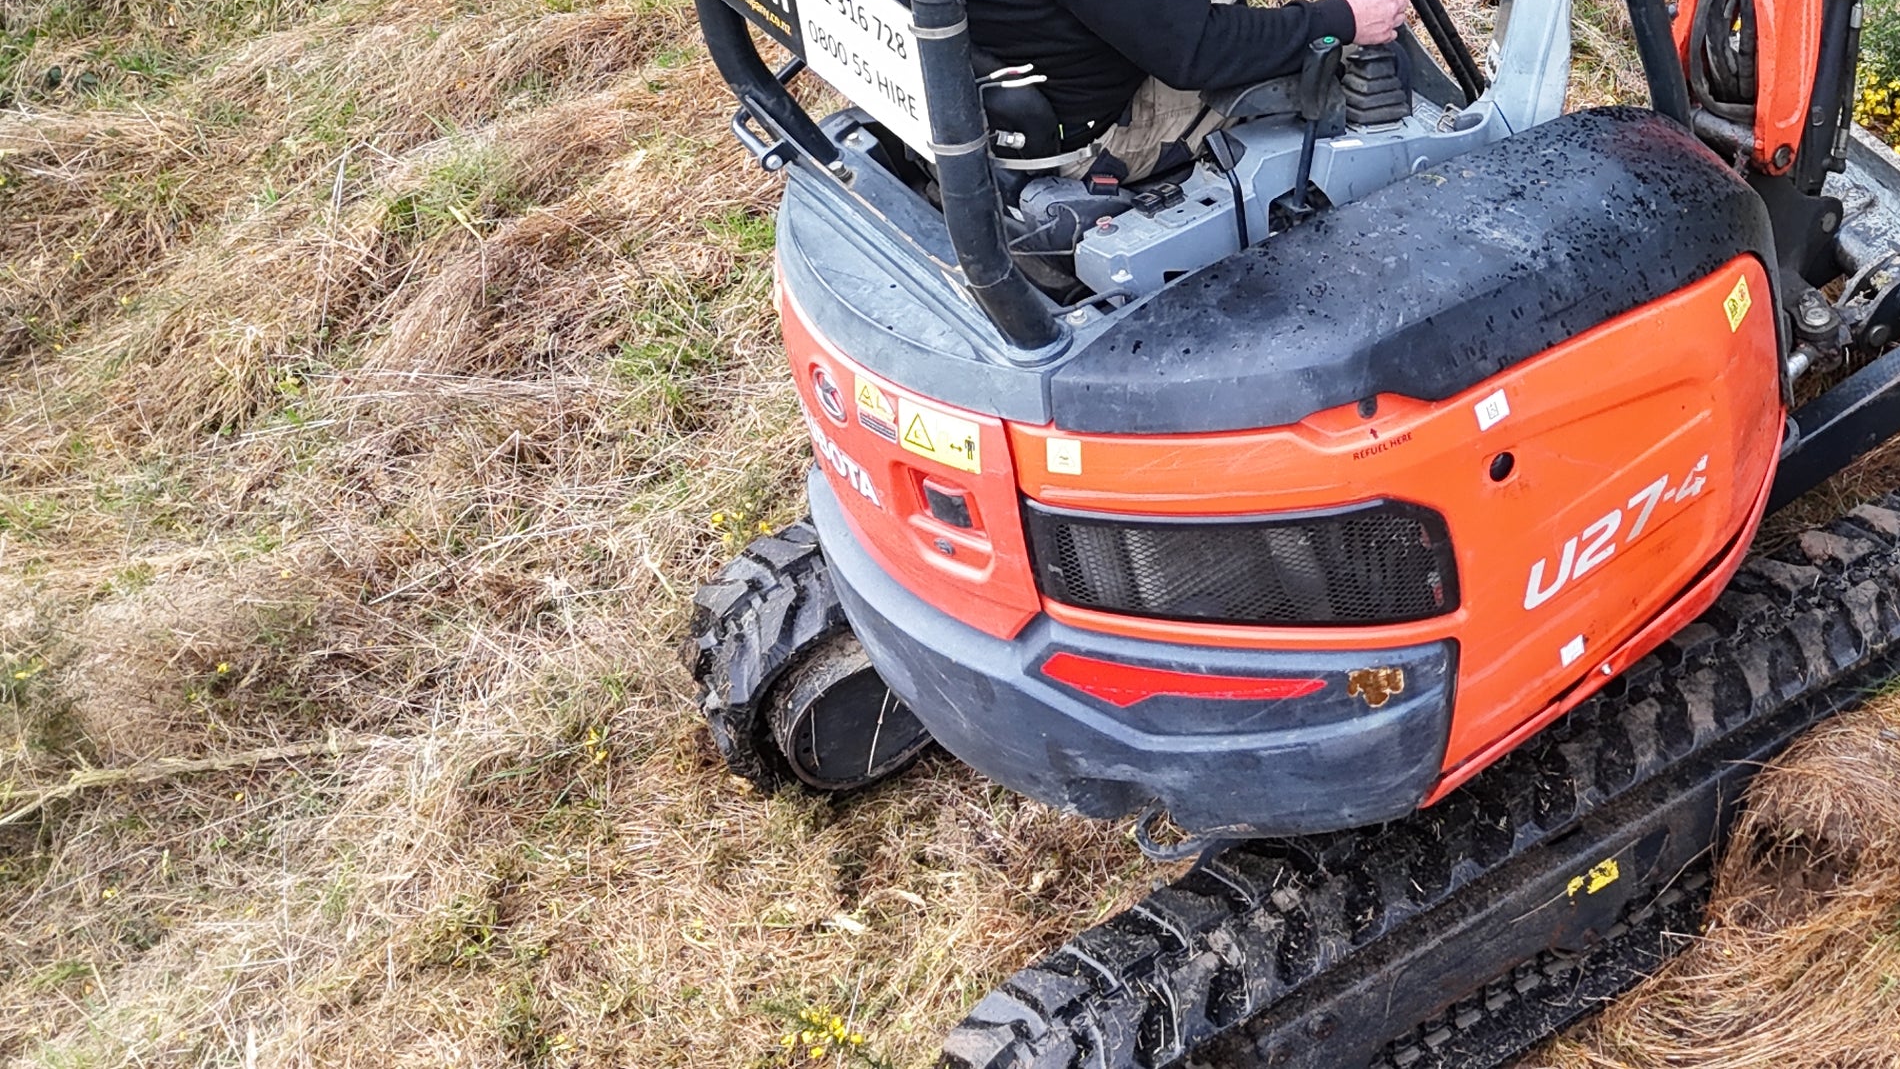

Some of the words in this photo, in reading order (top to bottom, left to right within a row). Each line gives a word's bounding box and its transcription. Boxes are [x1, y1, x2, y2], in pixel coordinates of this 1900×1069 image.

[808, 19, 848, 66] 0800
[852, 52, 873, 85] 55
[876, 70, 920, 122] HIRE
[871, 14, 908, 60] 728
[1352, 443, 1389, 461] REFUEL
[1389, 432, 1413, 448] HERE
[1523, 454, 1709, 611] U27-4
